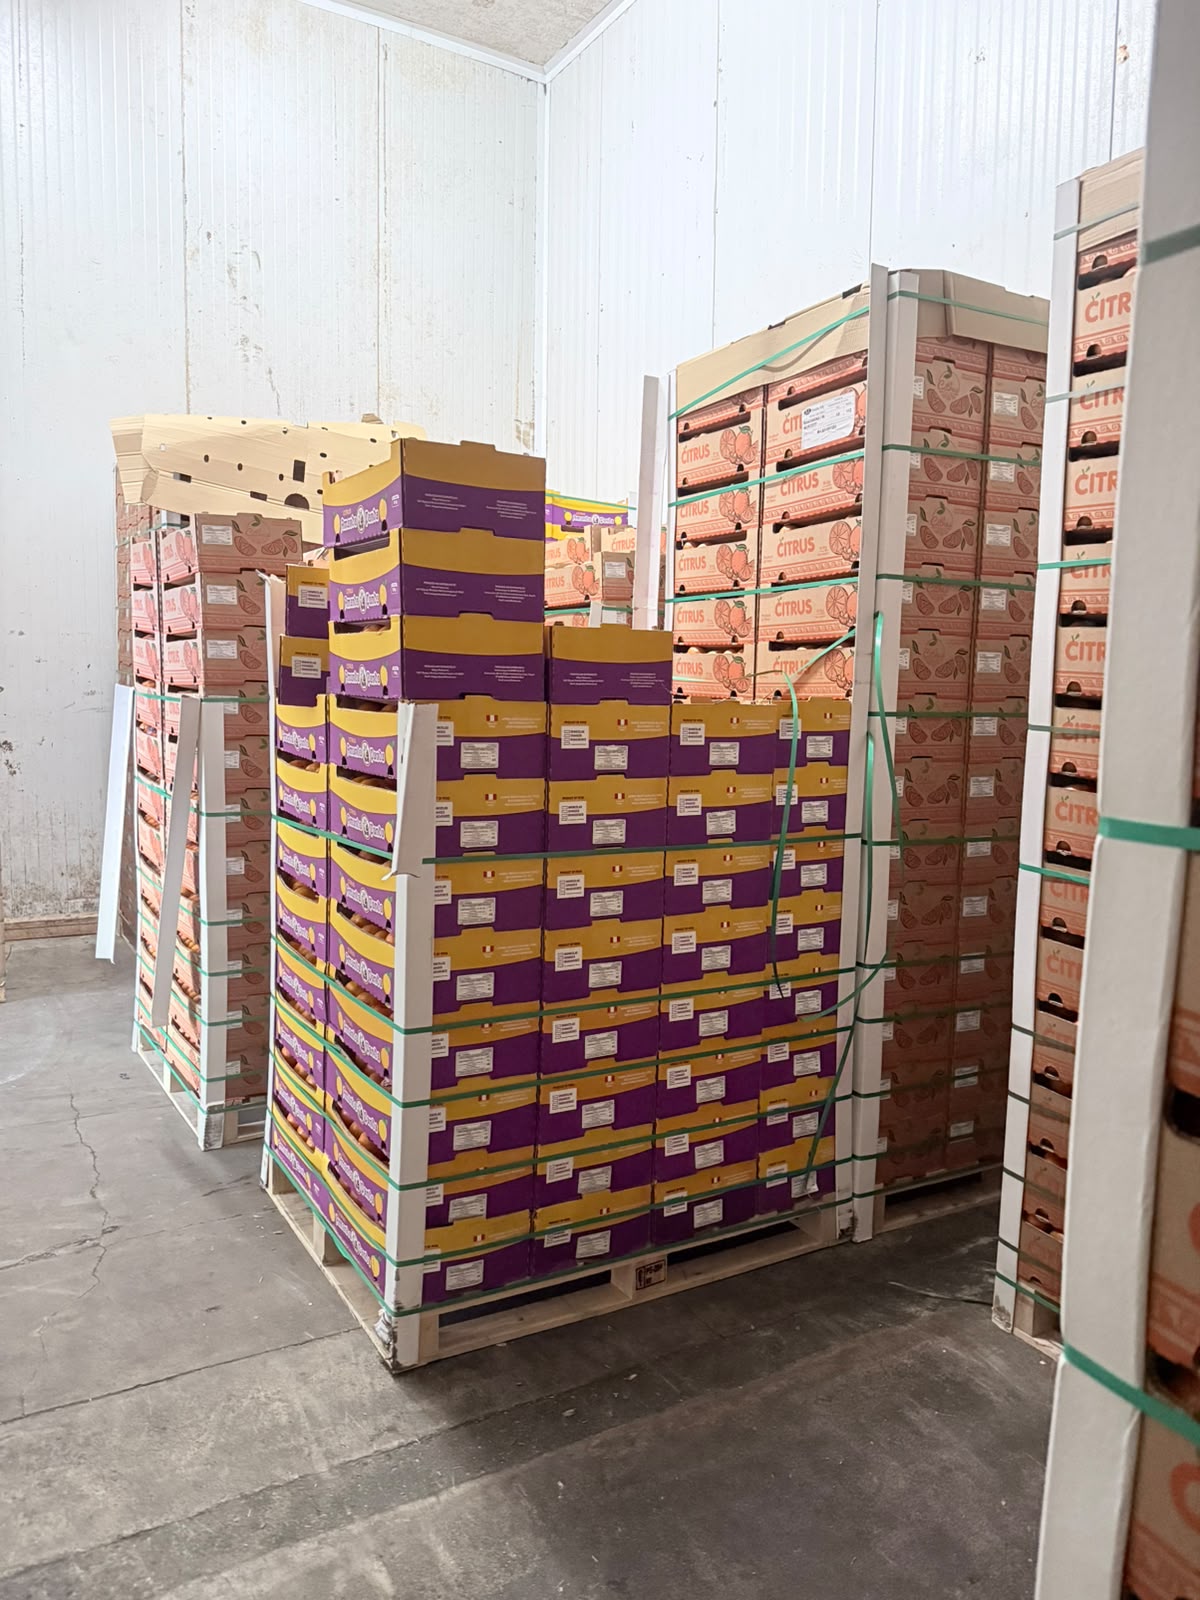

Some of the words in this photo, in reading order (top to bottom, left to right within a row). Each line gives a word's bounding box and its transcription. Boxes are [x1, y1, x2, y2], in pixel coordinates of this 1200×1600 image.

[1085, 292, 1131, 323] CITR
[1080, 387, 1124, 410] CITR
[782, 412, 802, 434] CIT
[681, 443, 710, 464] CITRUS
[780, 472, 819, 496] CITRUS
[1074, 470, 1118, 495] CITR
[680, 500, 709, 518] CITRUS
[777, 537, 815, 558] CITRUS
[678, 555, 707, 572] CITRUS
[545, 576, 564, 589] ITRUS
[677, 609, 704, 624] CITRUS
[775, 599, 812, 617] CITRUS
[1065, 641, 1106, 662] CITR
[676, 661, 703, 676] CITRUS
[1055, 801, 1098, 825] CITR
